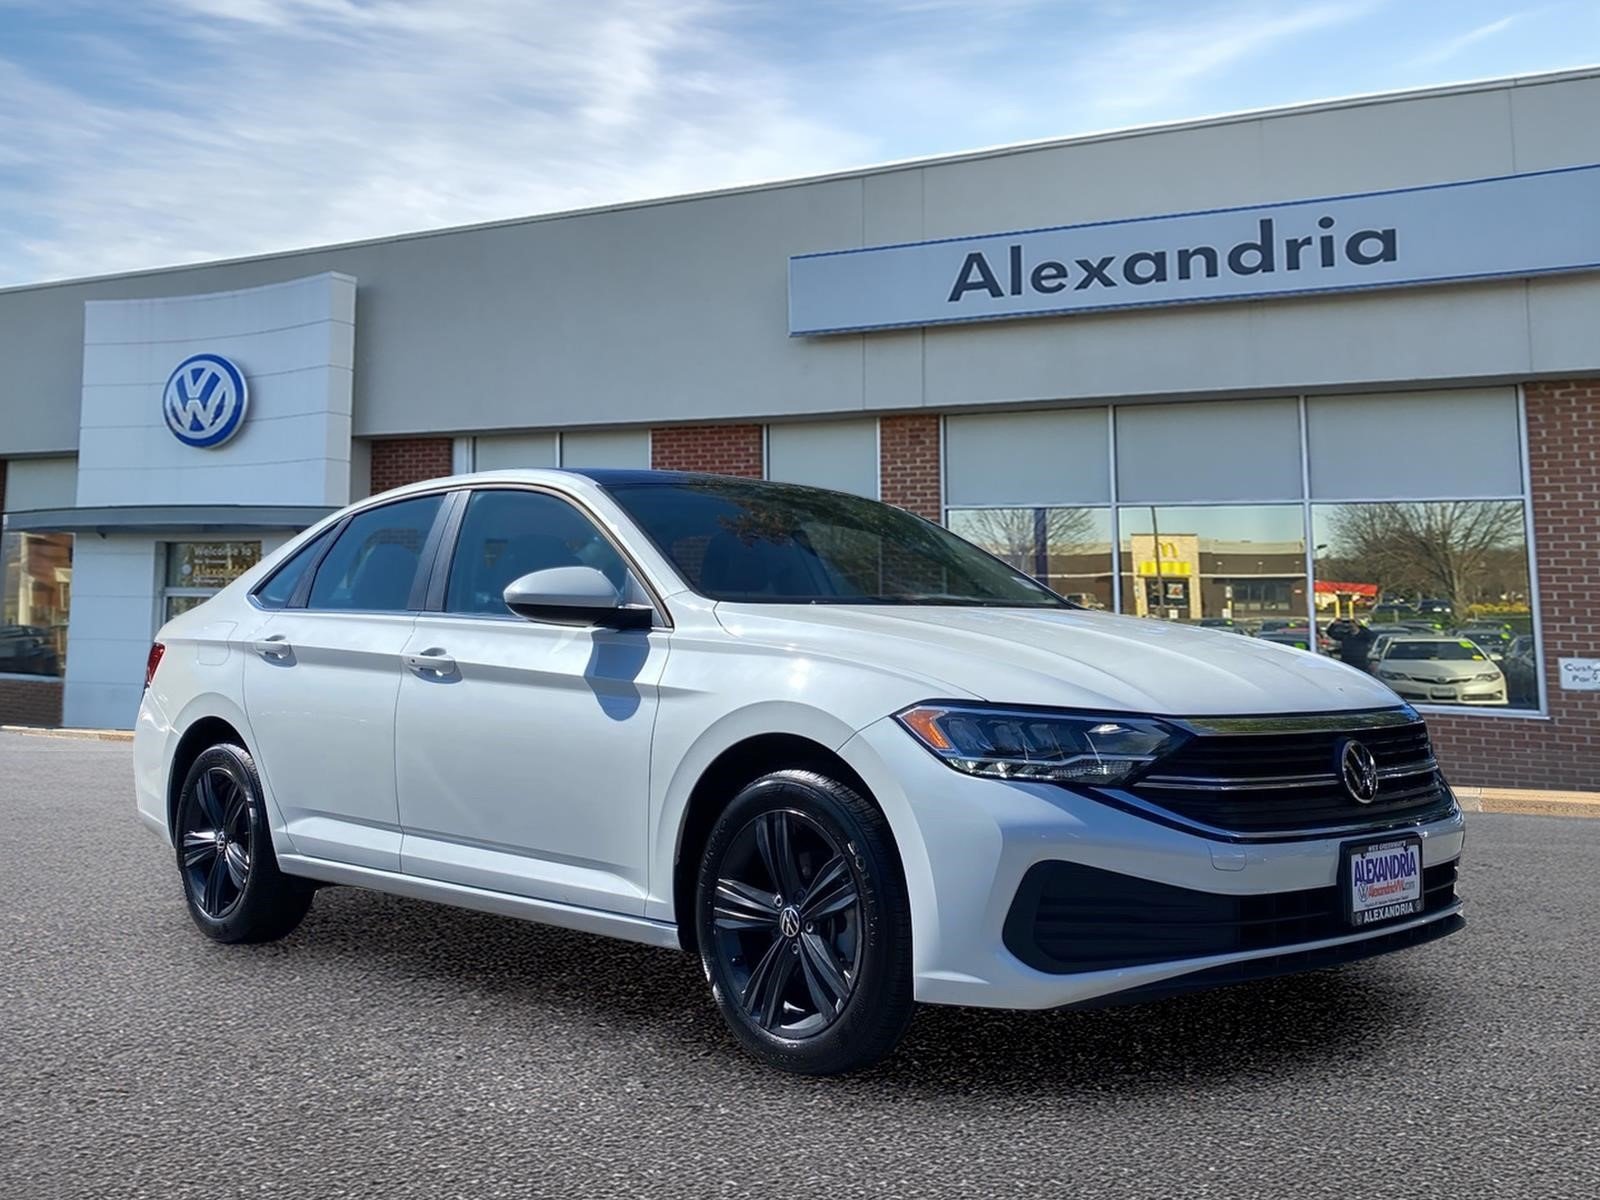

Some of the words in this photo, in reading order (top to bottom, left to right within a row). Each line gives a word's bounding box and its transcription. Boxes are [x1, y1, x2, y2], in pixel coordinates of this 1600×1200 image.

[947, 215, 1398, 303] Alexandria
[1354, 851, 1417, 887] ALEXANDRIA
[1363, 902, 1414, 924] ALEXANDRIA
